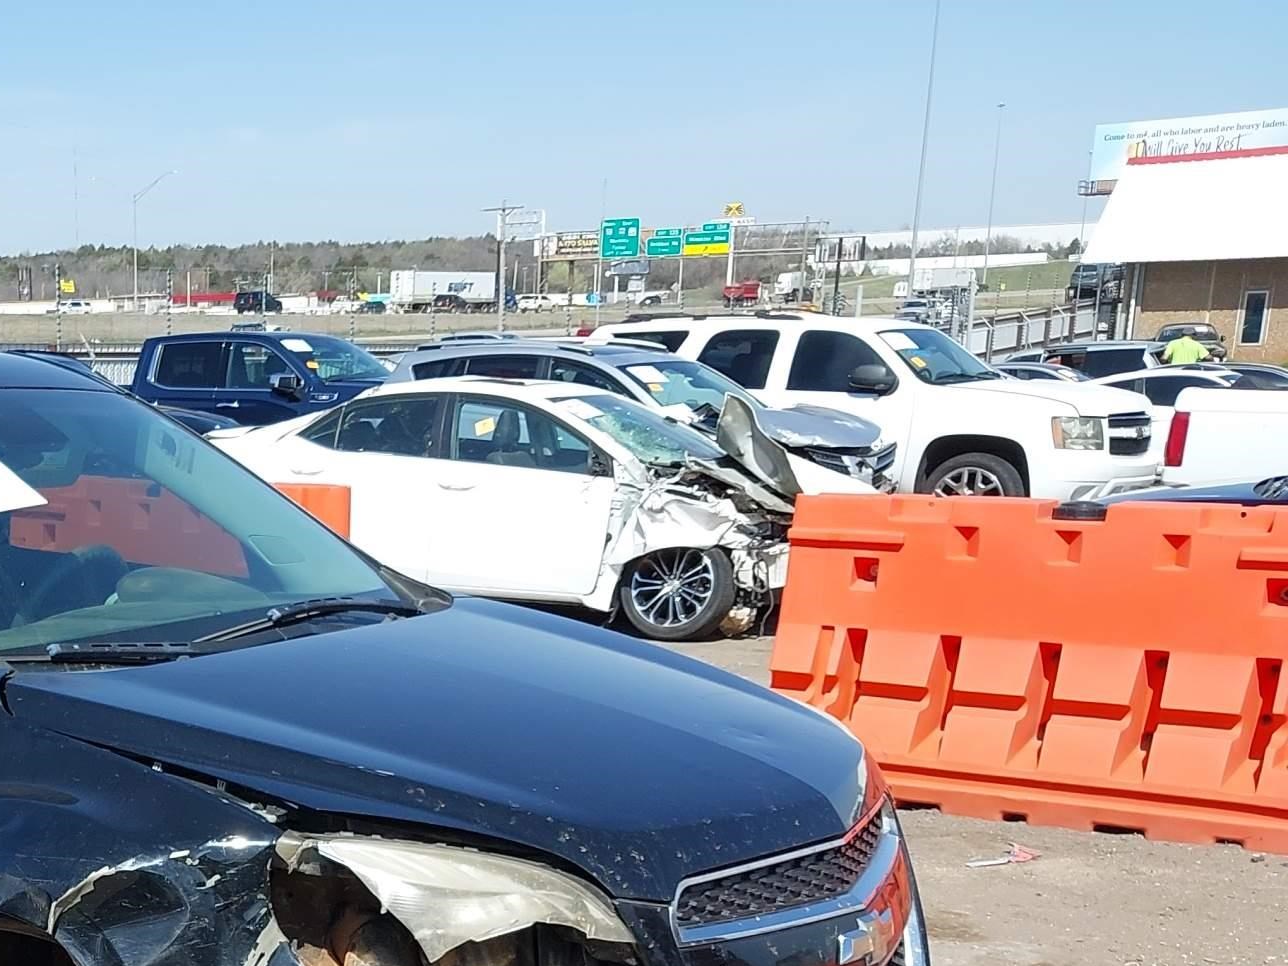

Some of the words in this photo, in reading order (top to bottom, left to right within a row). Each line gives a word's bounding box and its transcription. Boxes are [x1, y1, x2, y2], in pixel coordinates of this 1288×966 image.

[1103, 133, 1126, 142] Come
[1126, 132, 1135, 140] to
[1151, 129, 1162, 138] all
[1163, 128, 1179, 136] who
[1180, 126, 1203, 136] labor
[1203, 125, 1219, 134] and
[1220, 124, 1235, 132] are
[1235, 121, 1260, 131] heavy
[1261, 119, 1288, 128] laden.
[1194, 136, 1212, 153] You
